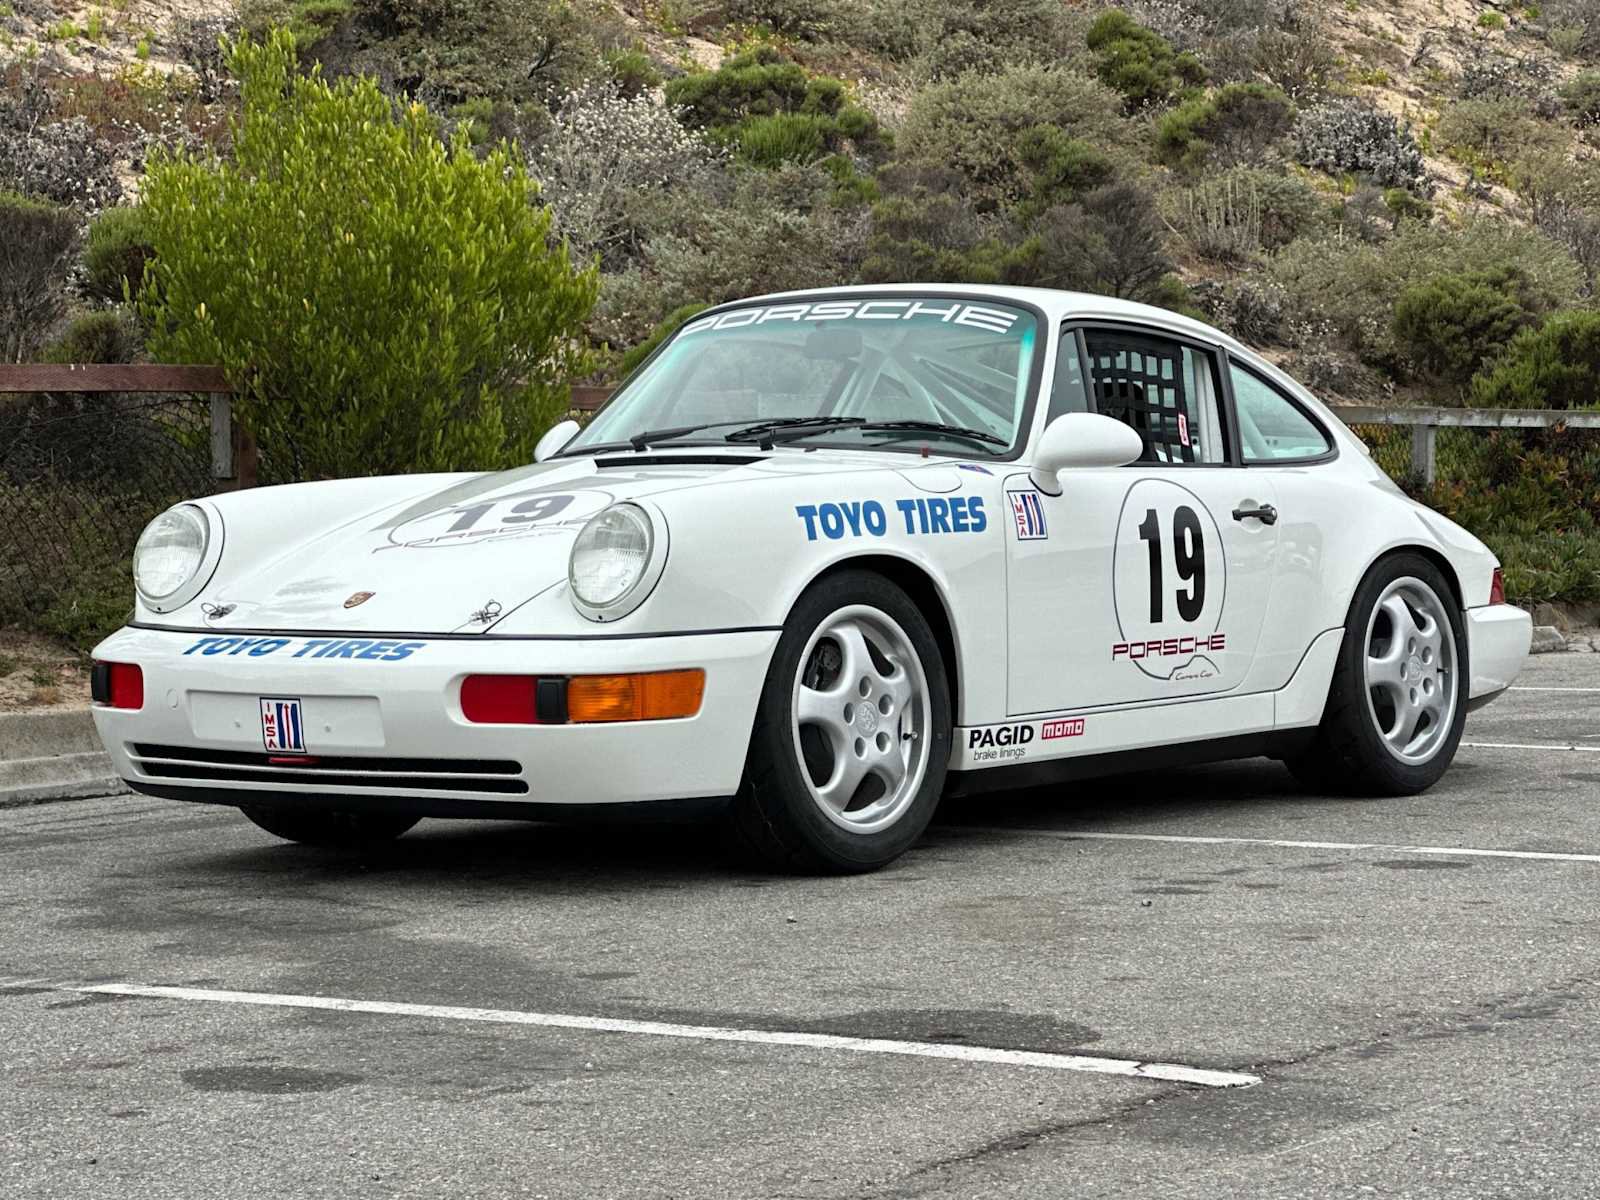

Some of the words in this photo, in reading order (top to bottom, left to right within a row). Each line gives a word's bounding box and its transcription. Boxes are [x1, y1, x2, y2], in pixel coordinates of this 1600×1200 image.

[677, 301, 1018, 336] PORSCHE
[446, 495, 576, 533] 19
[795, 500, 887, 541] TOYO
[896, 496, 987, 535] TIRES
[1014, 493, 1028, 536] IMSA
[1138, 505, 1206, 623] 19
[182, 637, 291, 657] TOYO
[292, 640, 428, 661] TIRES
[1113, 634, 1225, 661] PORSCHE
[264, 702, 279, 750] IMSA
[969, 725, 1034, 748] PAGID
[1042, 720, 1084, 739] momo
[973, 749, 997, 761] brake
[999, 747, 1026, 760] linings
